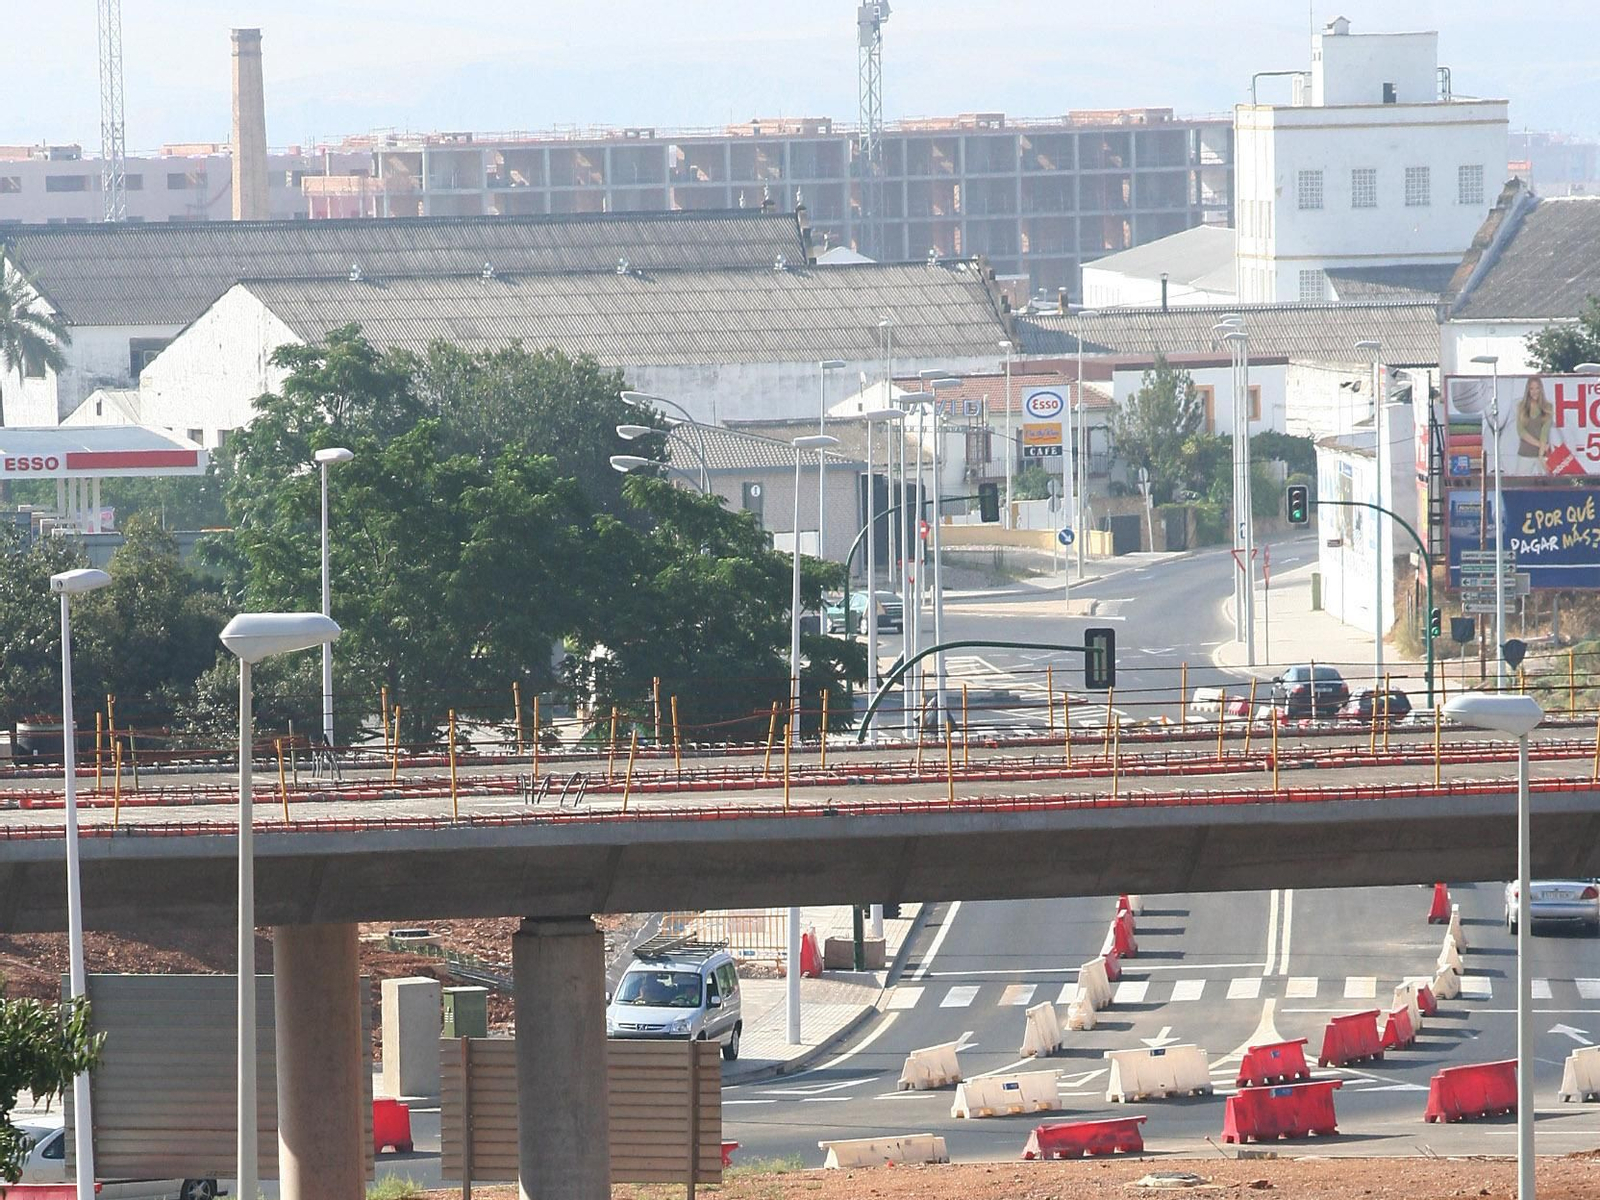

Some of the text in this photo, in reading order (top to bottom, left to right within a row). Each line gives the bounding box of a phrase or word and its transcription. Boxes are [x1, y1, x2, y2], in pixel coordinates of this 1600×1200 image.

[5, 456, 60, 471] ESSO
[1522, 509, 1563, 534] ¿POR
[1510, 535, 1559, 555] PAGAR
